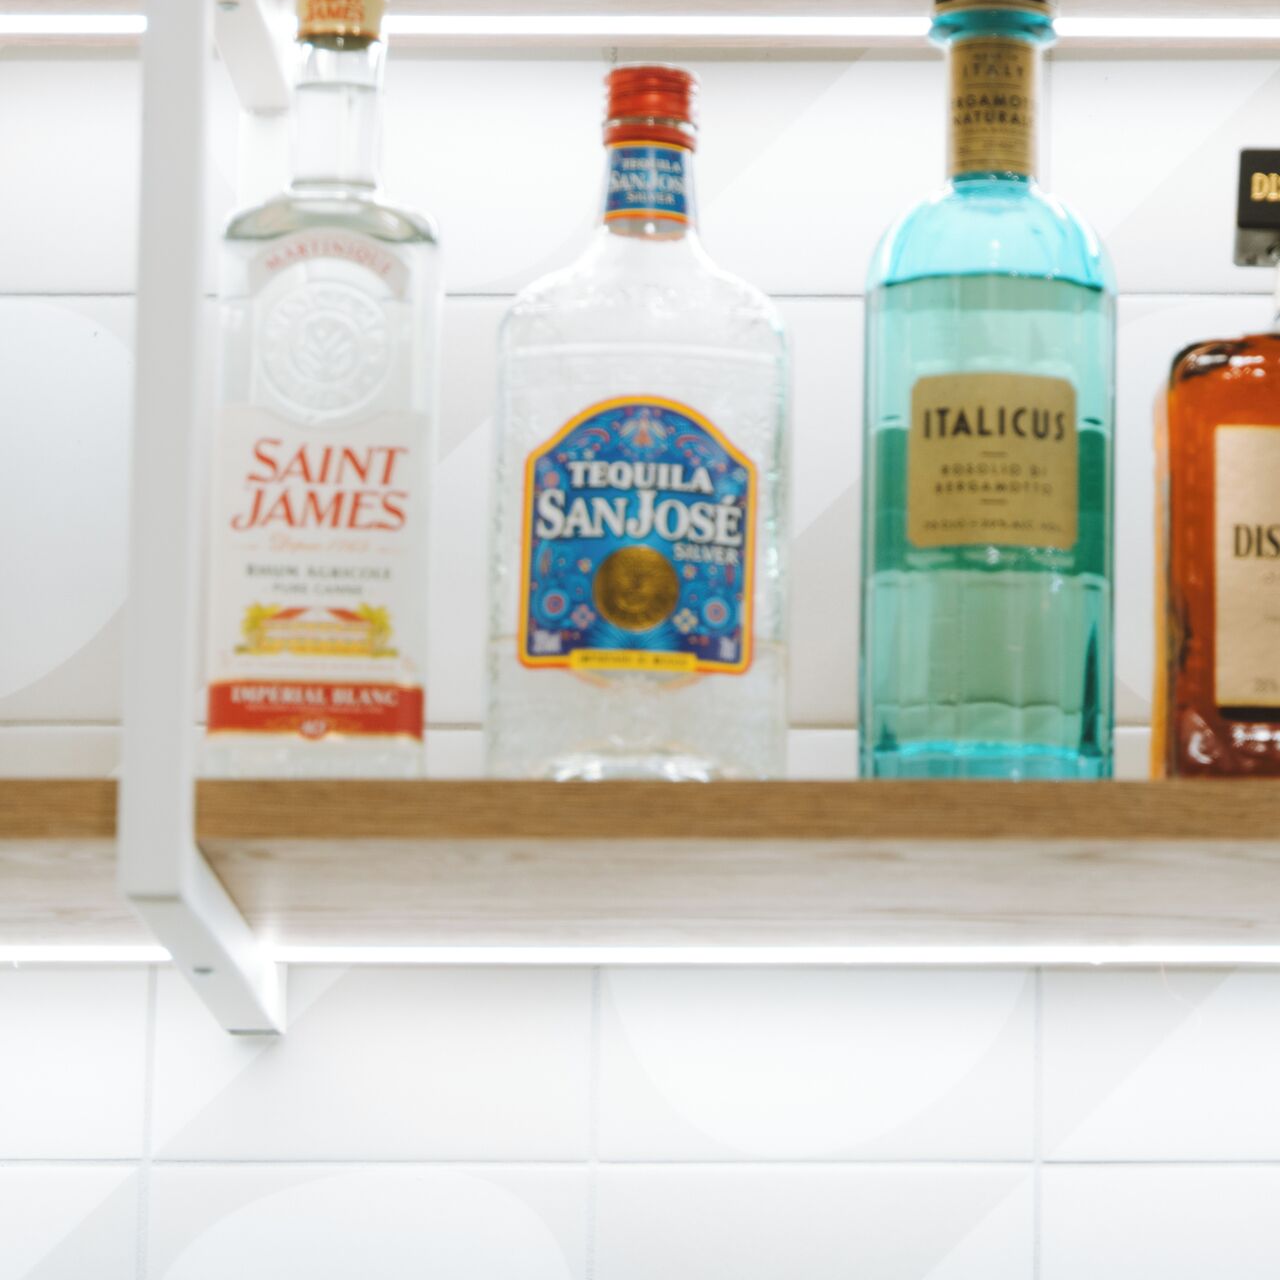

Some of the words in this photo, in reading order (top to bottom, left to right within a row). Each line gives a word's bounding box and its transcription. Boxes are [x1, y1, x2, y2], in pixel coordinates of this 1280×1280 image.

[922, 403, 1066, 444] ITALICUS
[245, 438, 411, 487] SAINT
[567, 460, 716, 496] TEQUILA
[229, 486, 410, 533] JAMES
[673, 542, 739, 568] SILVER
